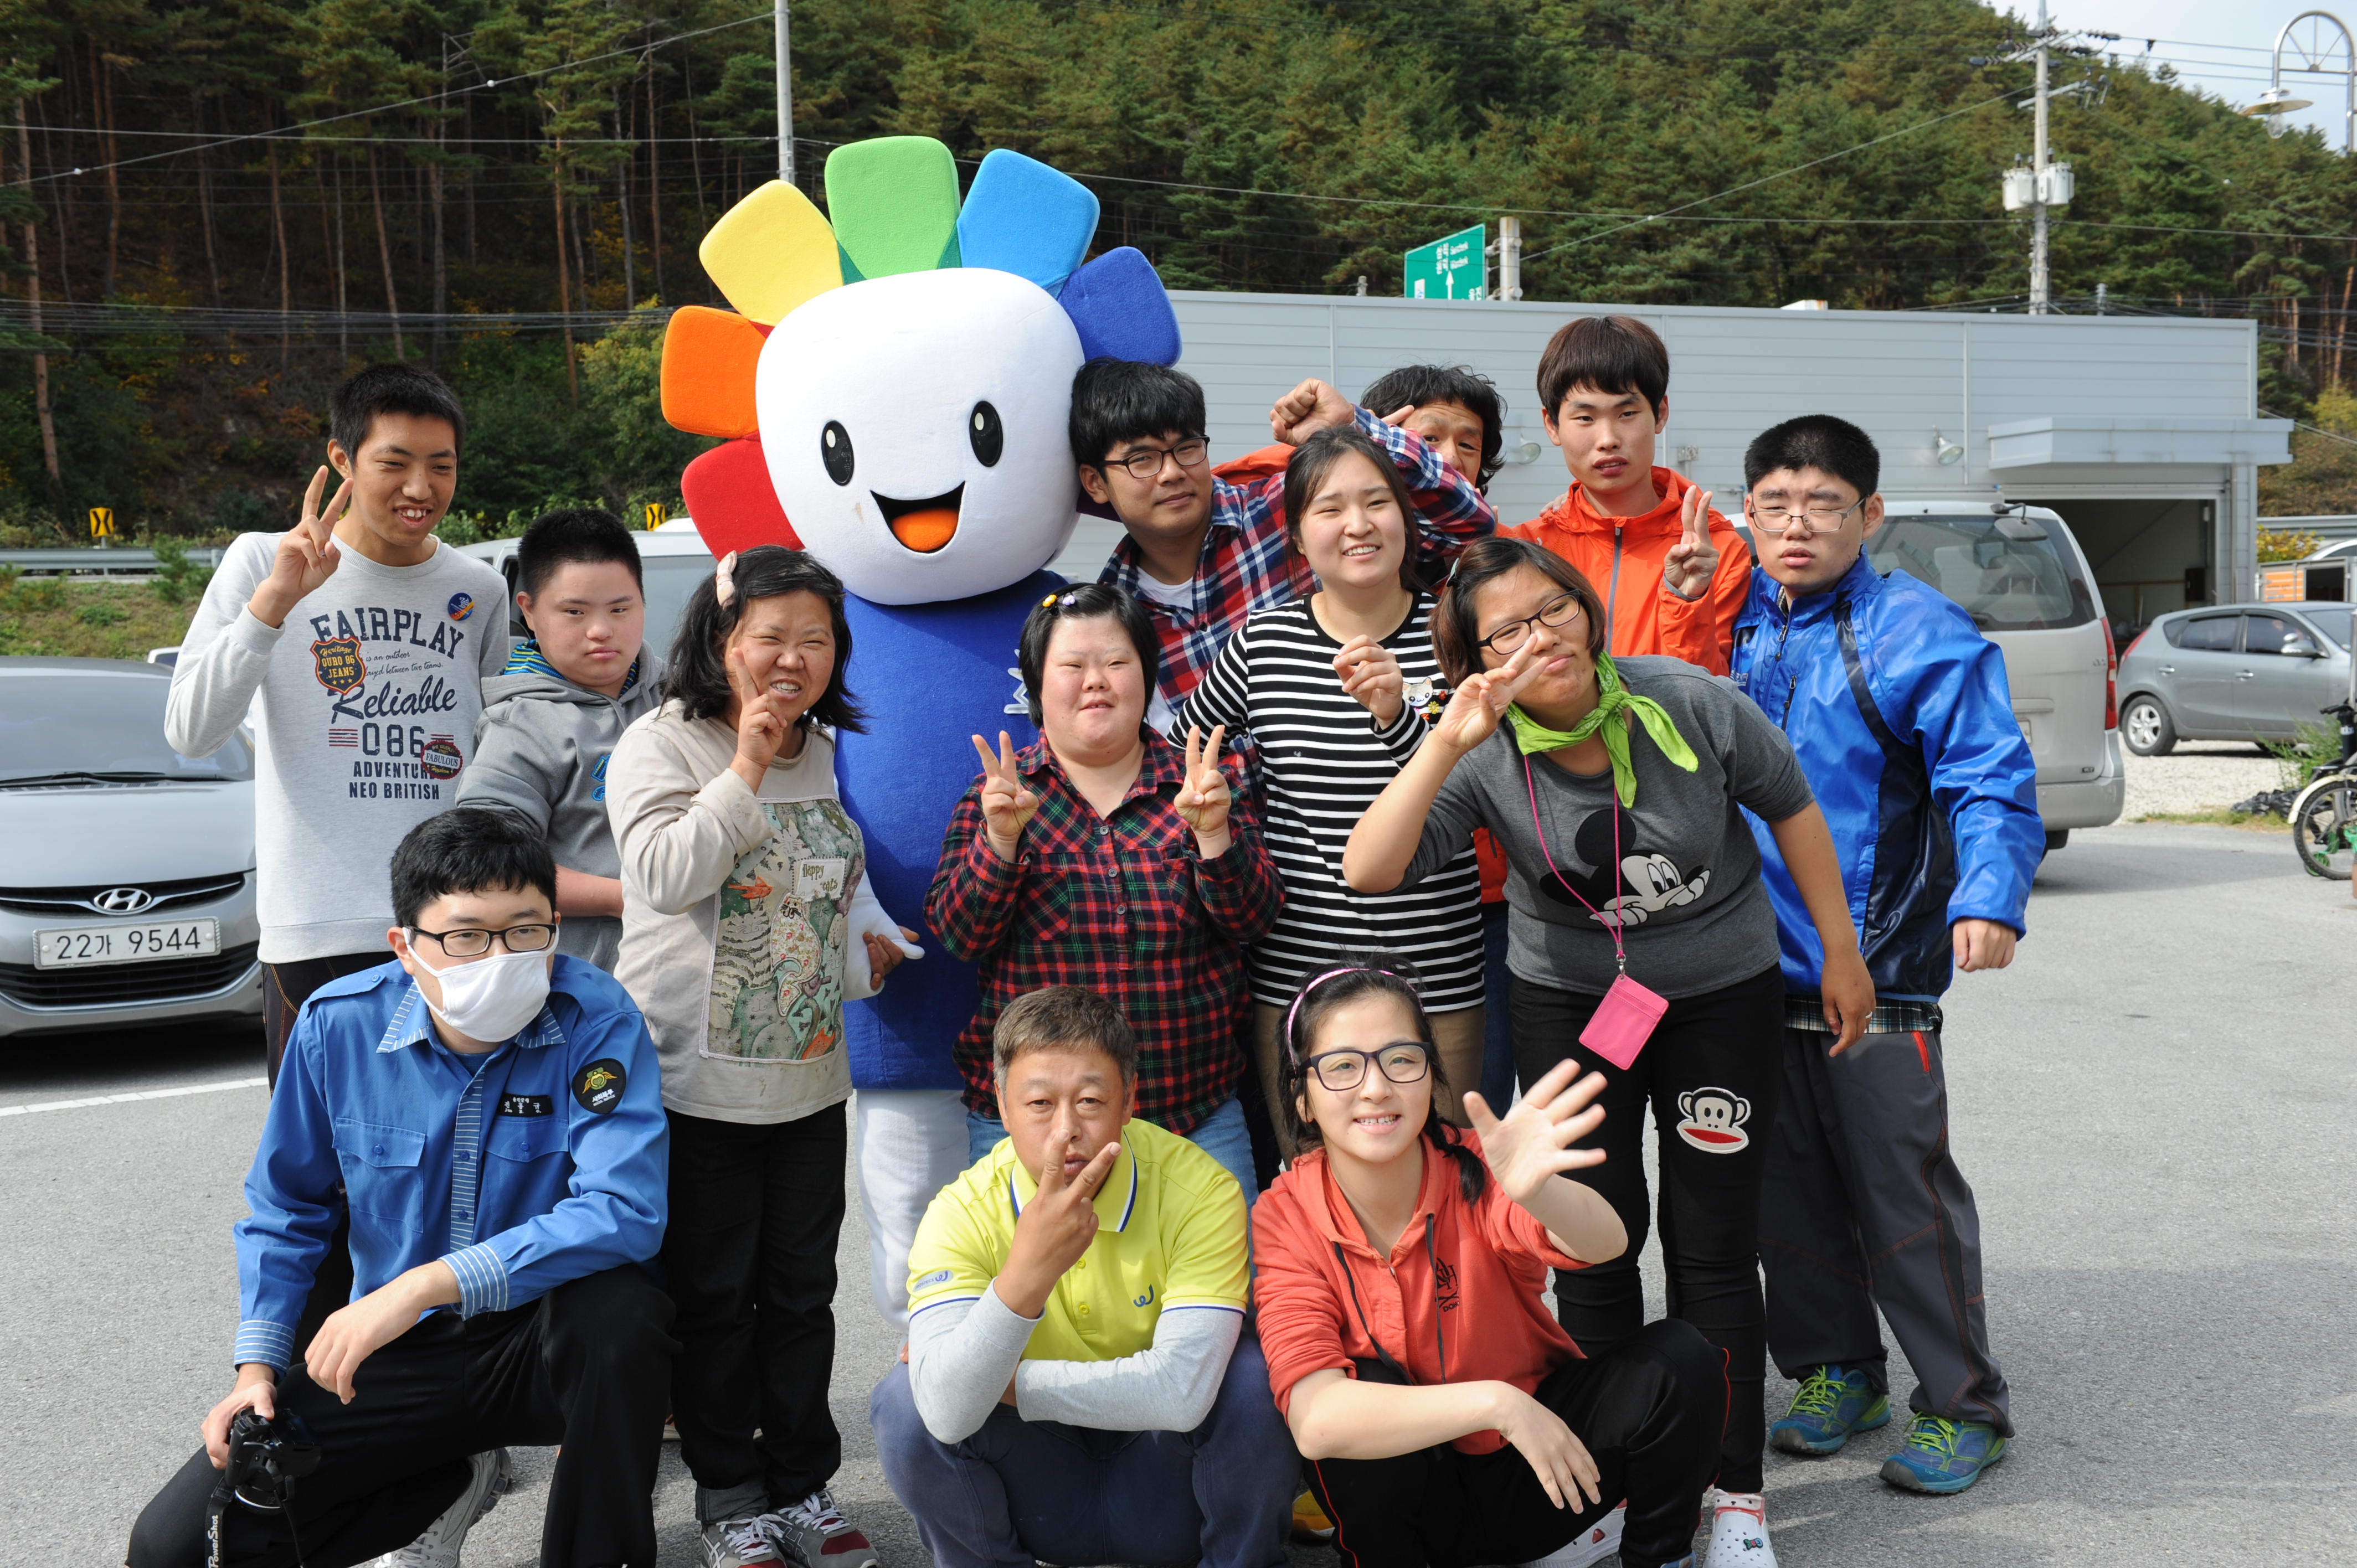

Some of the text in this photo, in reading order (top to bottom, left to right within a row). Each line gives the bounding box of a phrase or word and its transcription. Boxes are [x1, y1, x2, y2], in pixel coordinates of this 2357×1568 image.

[310, 607, 464, 659] FAIRPLAY
[320, 645, 352, 657] Heritage
[366, 652, 372, 662] is
[385, 648, 411, 660] outdoor
[345, 655, 355, 664] 86
[328, 666, 354, 678] JEANS
[366, 665, 384, 680] layed
[387, 664, 409, 674] between
[327, 674, 457, 724] Reliable
[362, 723, 425, 758] 086
[426, 753, 459, 767] FABULOUS
[353, 761, 434, 780] ADVENTUR
[349, 782, 439, 800] NEO BRITISH
[802, 864, 825, 880] Happy
[822, 878, 838, 892] cats
[57, 926, 200, 960] 22가 9544
[208, 1514, 219, 1568] PowerShot
